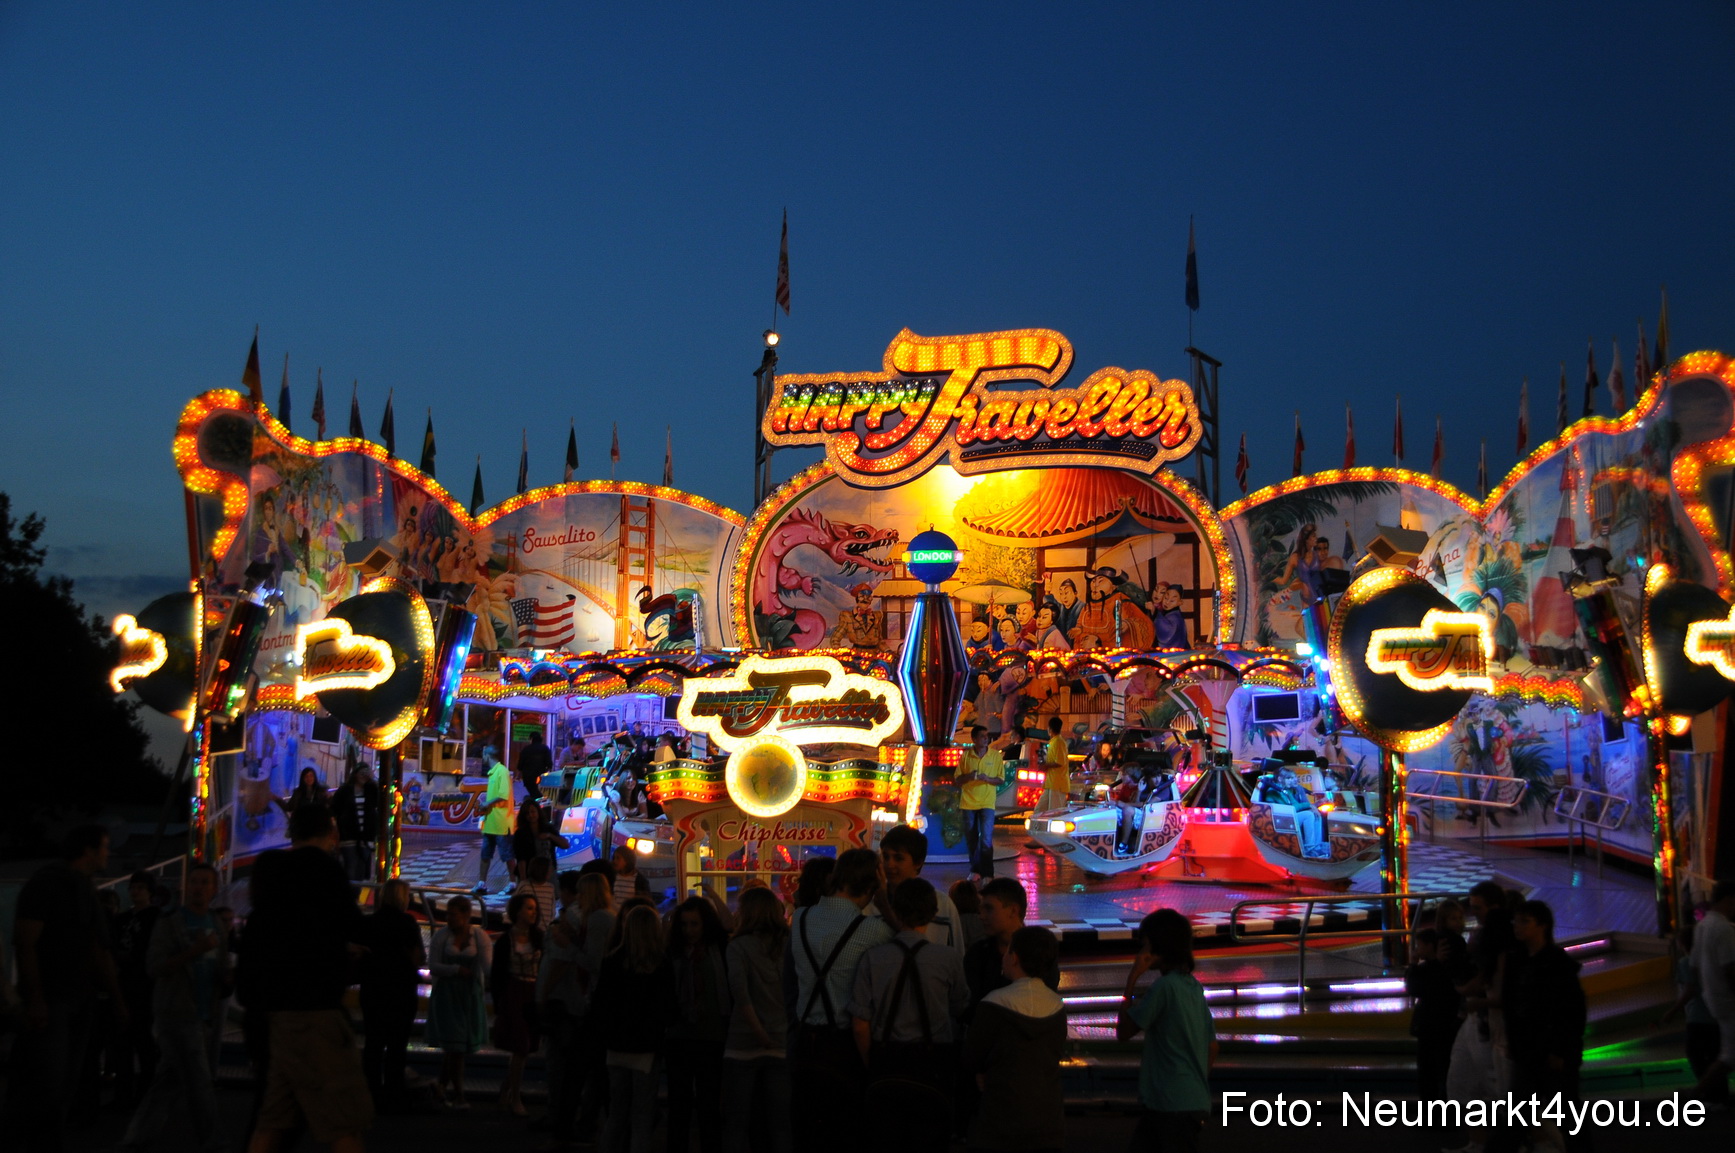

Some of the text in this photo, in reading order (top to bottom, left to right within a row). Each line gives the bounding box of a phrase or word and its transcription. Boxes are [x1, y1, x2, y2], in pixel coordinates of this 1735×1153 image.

[772, 336, 1191, 473] HAPPY Traveller
[522, 525, 596, 554] Sausalito
[913, 552, 952, 561] LONDON
[691, 670, 891, 738] HAPPY Traveller
[717, 821, 826, 848] Chipkasse
